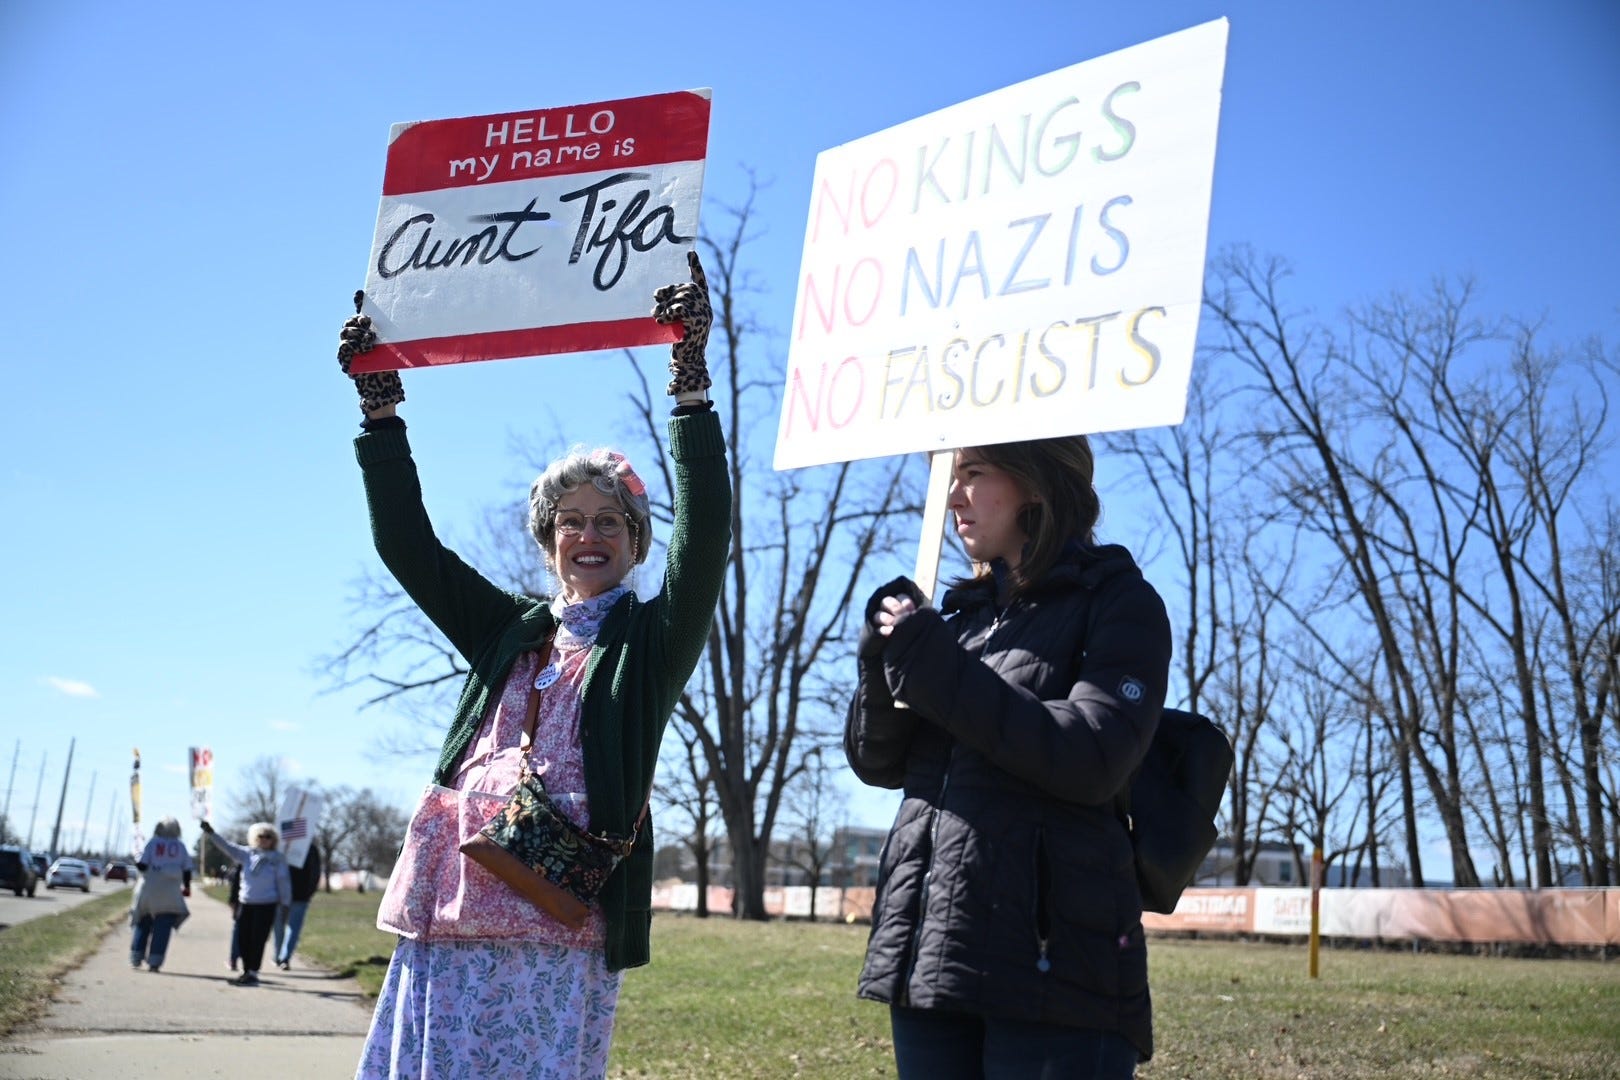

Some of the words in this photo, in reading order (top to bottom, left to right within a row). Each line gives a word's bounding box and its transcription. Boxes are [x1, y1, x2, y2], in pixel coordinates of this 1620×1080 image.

[449, 152, 499, 181] my
[511, 142, 600, 171] name
[613, 137, 635, 157] is
[485, 109, 616, 147] HELLO
[812, 157, 898, 243] NO
[911, 80, 1141, 214] KINGS
[560, 172, 697, 291] Tifa
[798, 256, 884, 341] NO
[899, 194, 1133, 316] NAZIS
[784, 355, 866, 440] NO
[879, 305, 1167, 419] FASCISTS
[155, 842, 179, 858] NO
